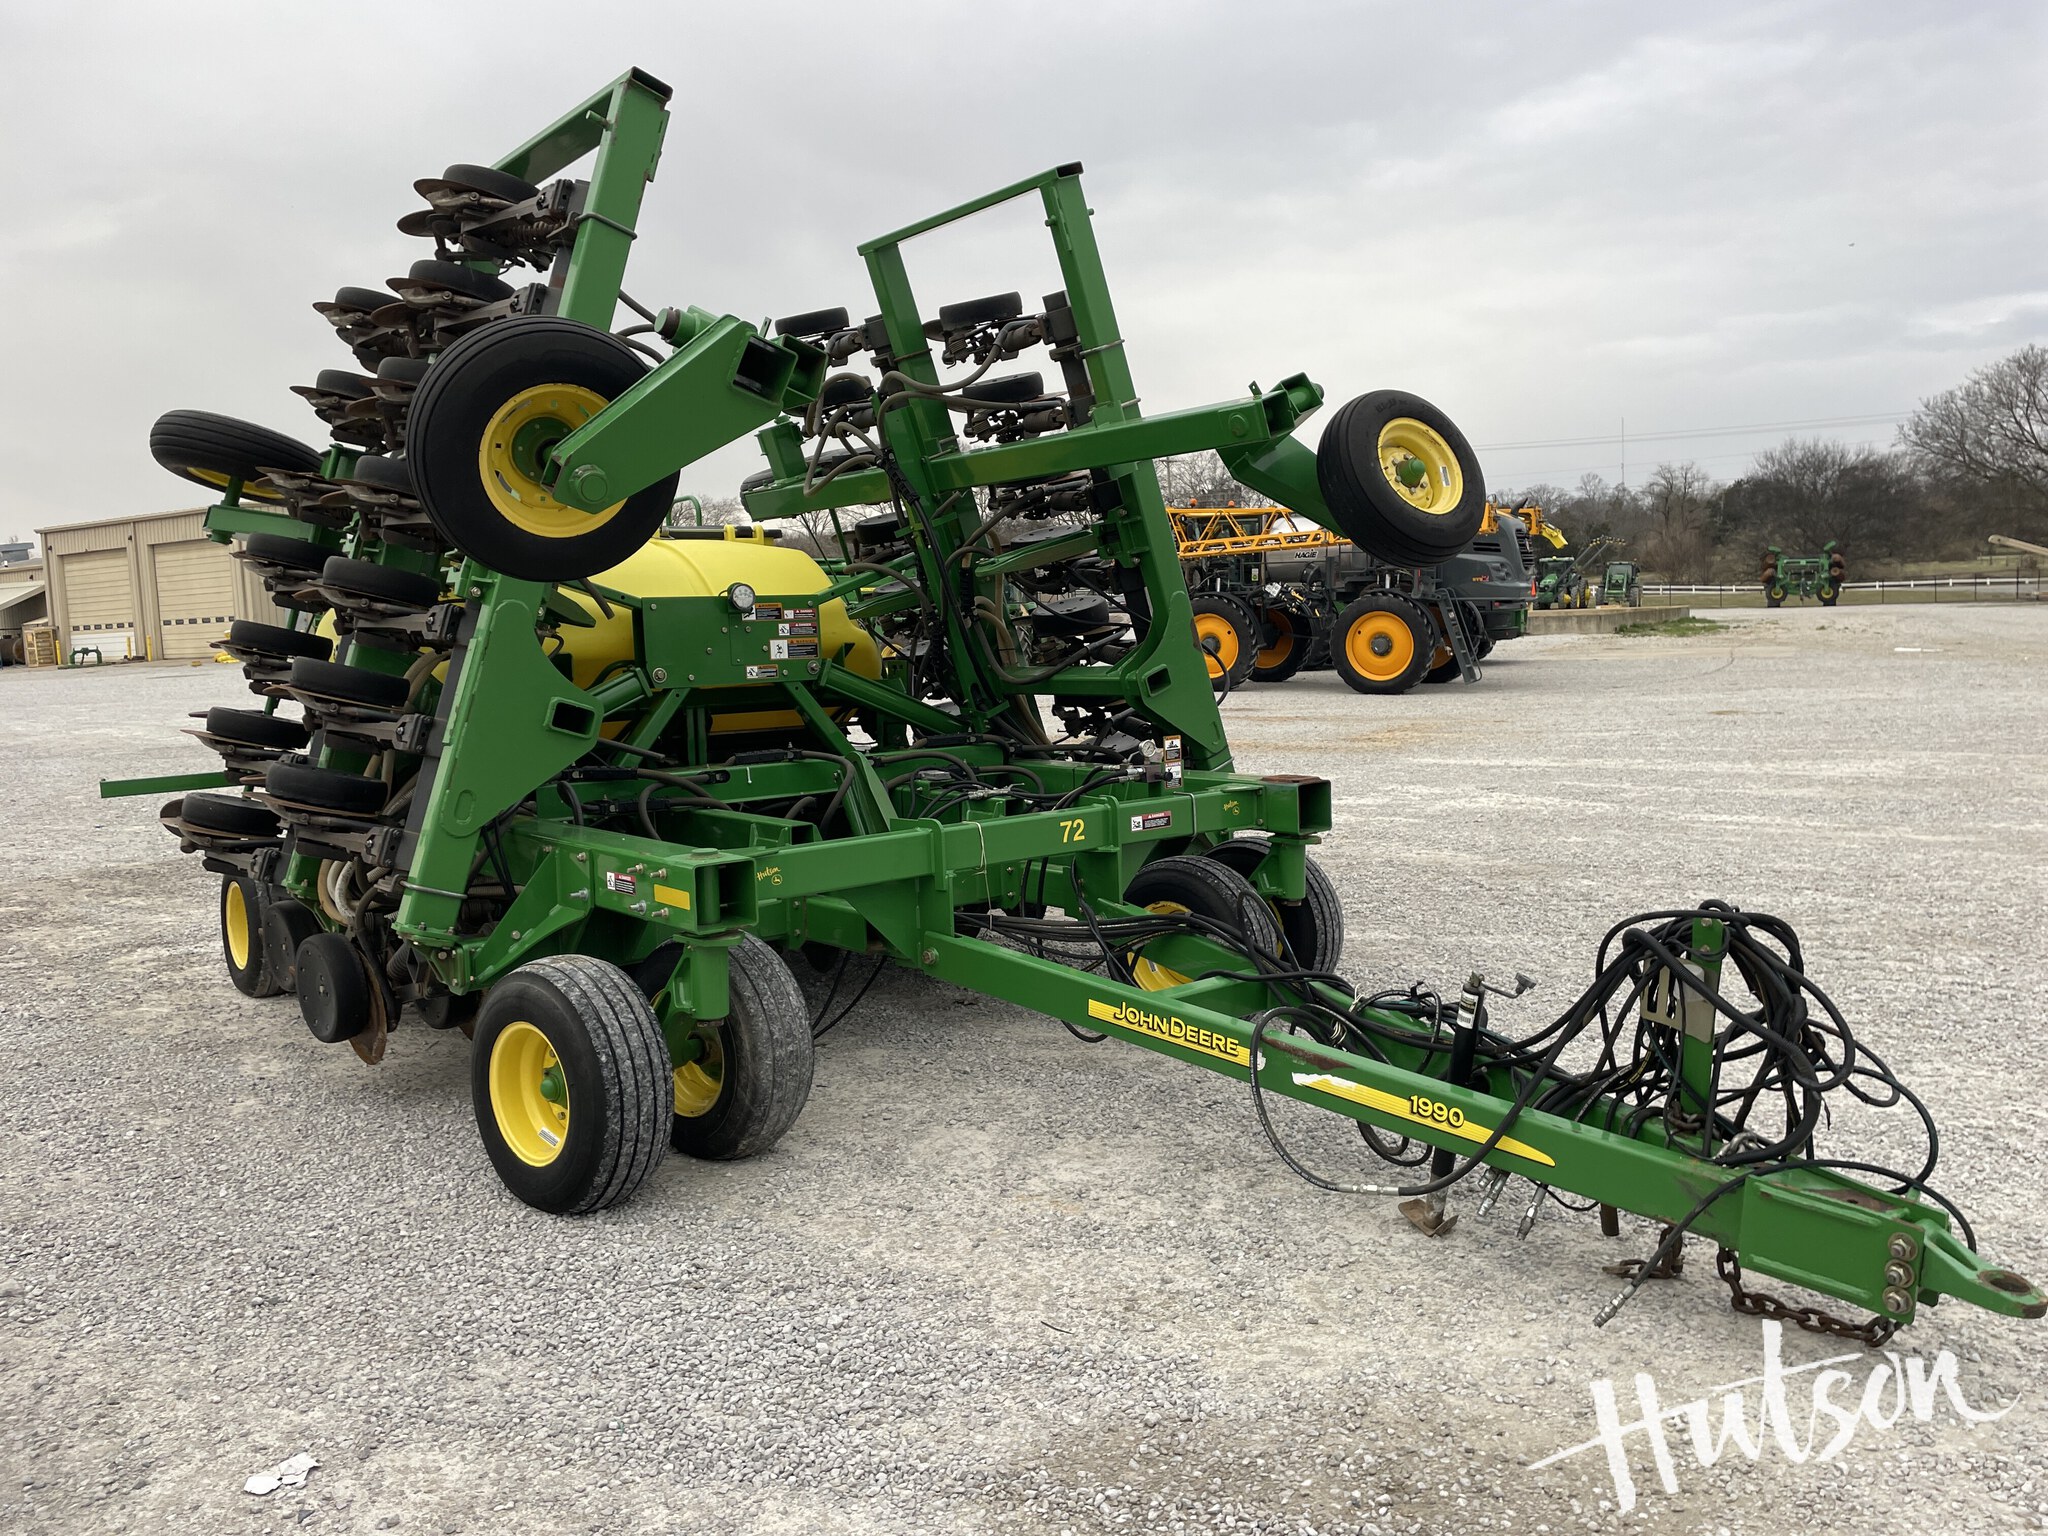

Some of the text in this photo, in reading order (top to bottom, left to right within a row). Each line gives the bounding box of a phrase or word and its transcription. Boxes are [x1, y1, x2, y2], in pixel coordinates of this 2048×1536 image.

[1060, 818, 1085, 843] 72
[756, 866, 781, 881] Hutson
[1114, 1001, 1240, 1056] JOHN DEERE
[1409, 1094, 1464, 1128] 1990
